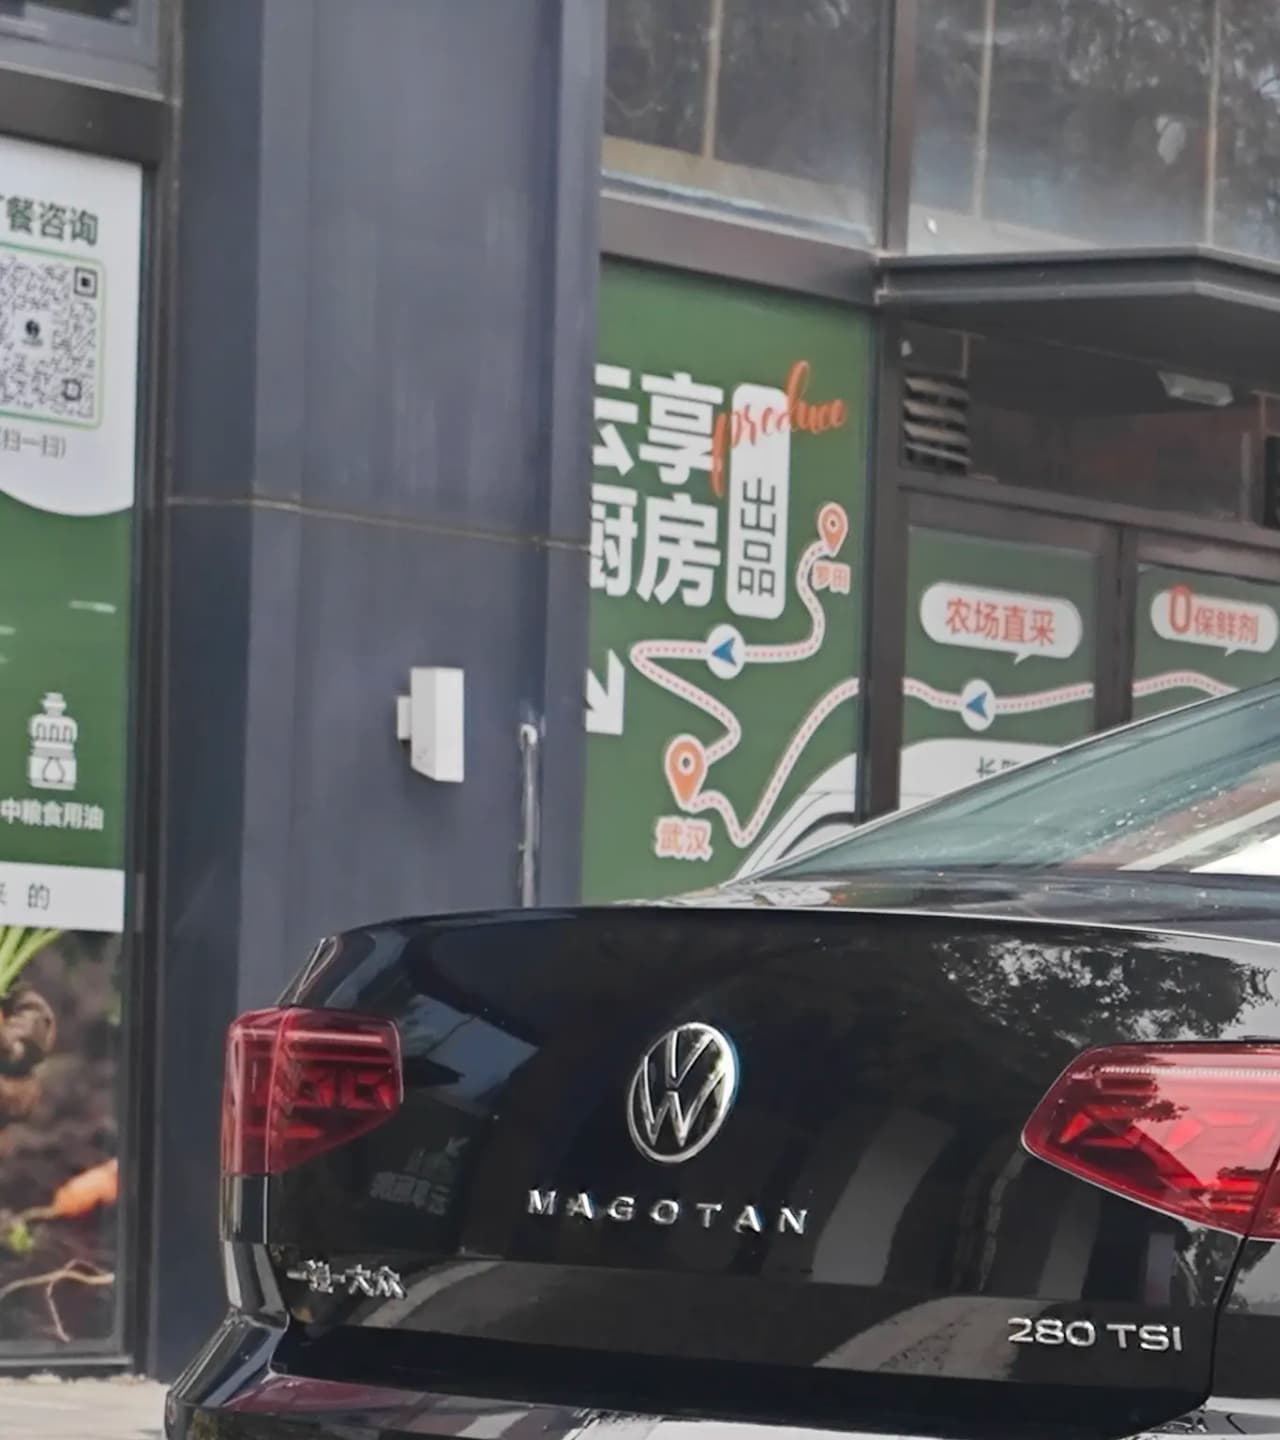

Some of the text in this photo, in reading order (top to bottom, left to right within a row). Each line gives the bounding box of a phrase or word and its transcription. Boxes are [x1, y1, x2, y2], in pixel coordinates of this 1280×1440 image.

[0, 194, 98, 246] 餐咨询
[709, 360, 847, 498] produce
[738, 477, 776, 598] 出品
[945, 597, 1055, 646] 农场直采
[655, 815, 713, 862] 武汉
[527, 1187, 808, 1234] MAGOTAN
[1007, 1317, 1183, 1351] 280 TSI
